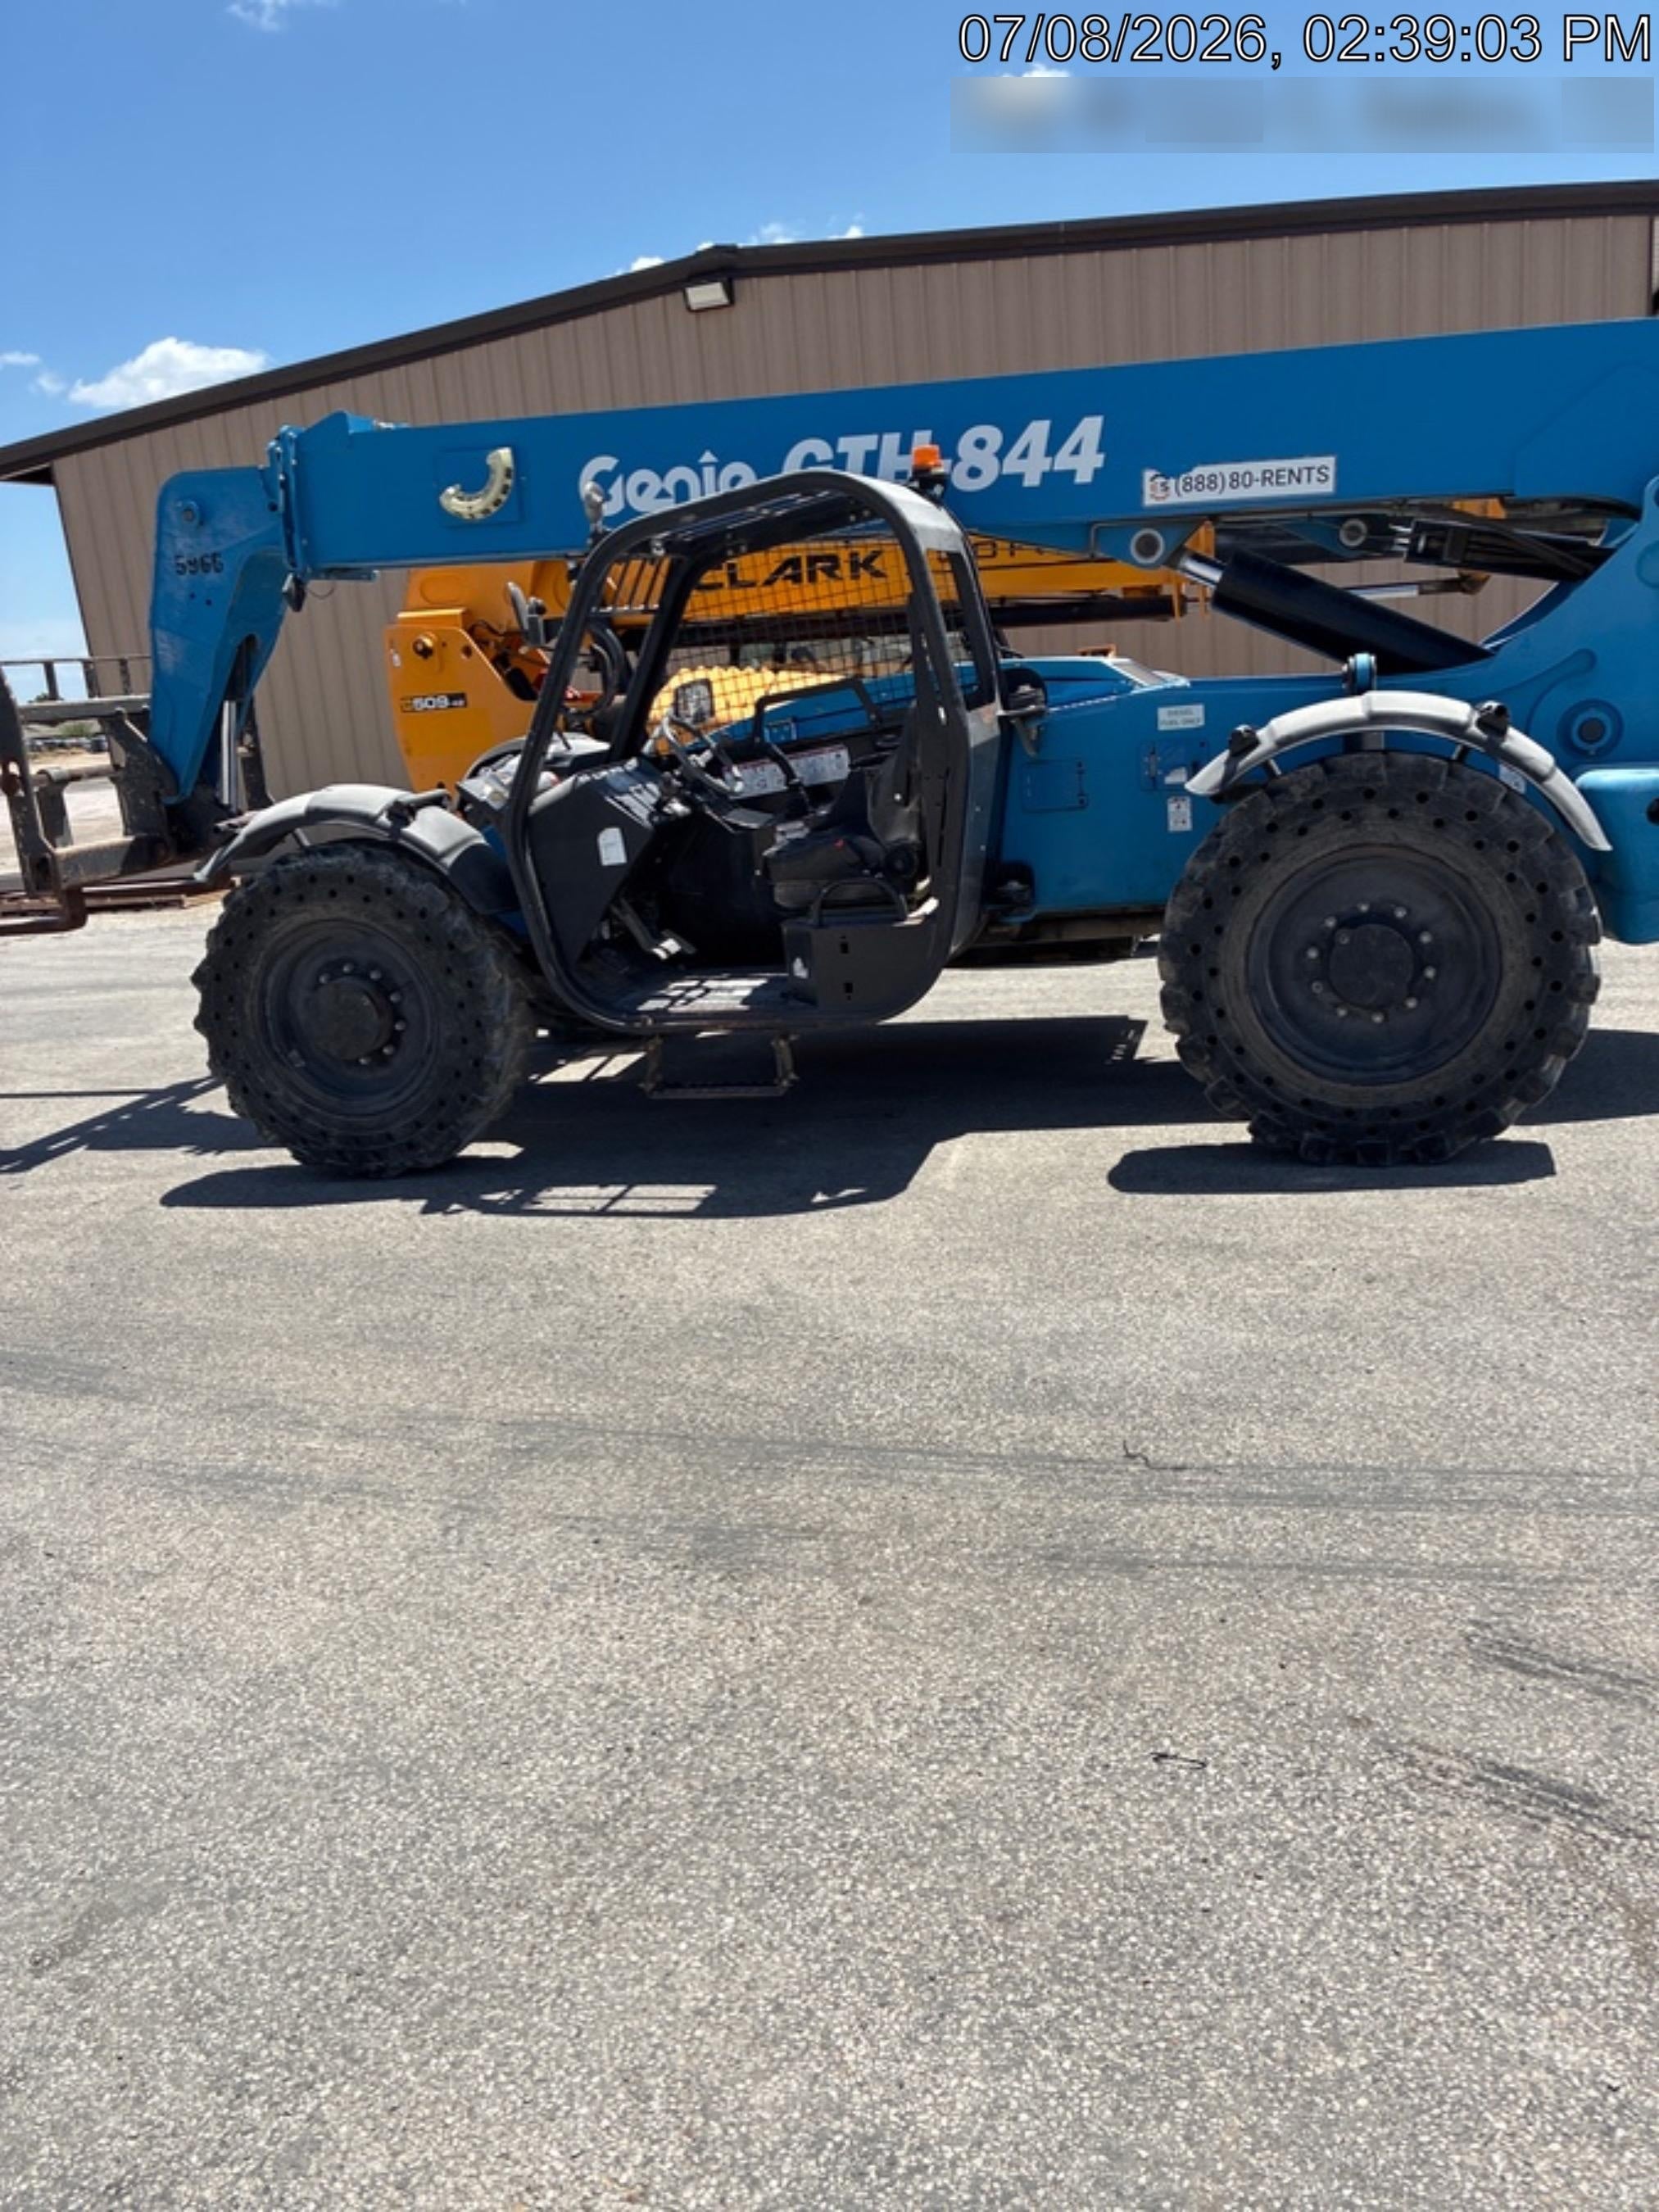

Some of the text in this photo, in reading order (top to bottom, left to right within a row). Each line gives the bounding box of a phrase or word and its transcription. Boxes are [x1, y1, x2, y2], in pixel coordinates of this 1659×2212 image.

[579, 450, 758, 517] Genie
[1175, 465, 1330, 497] (888) 80-RENTS
